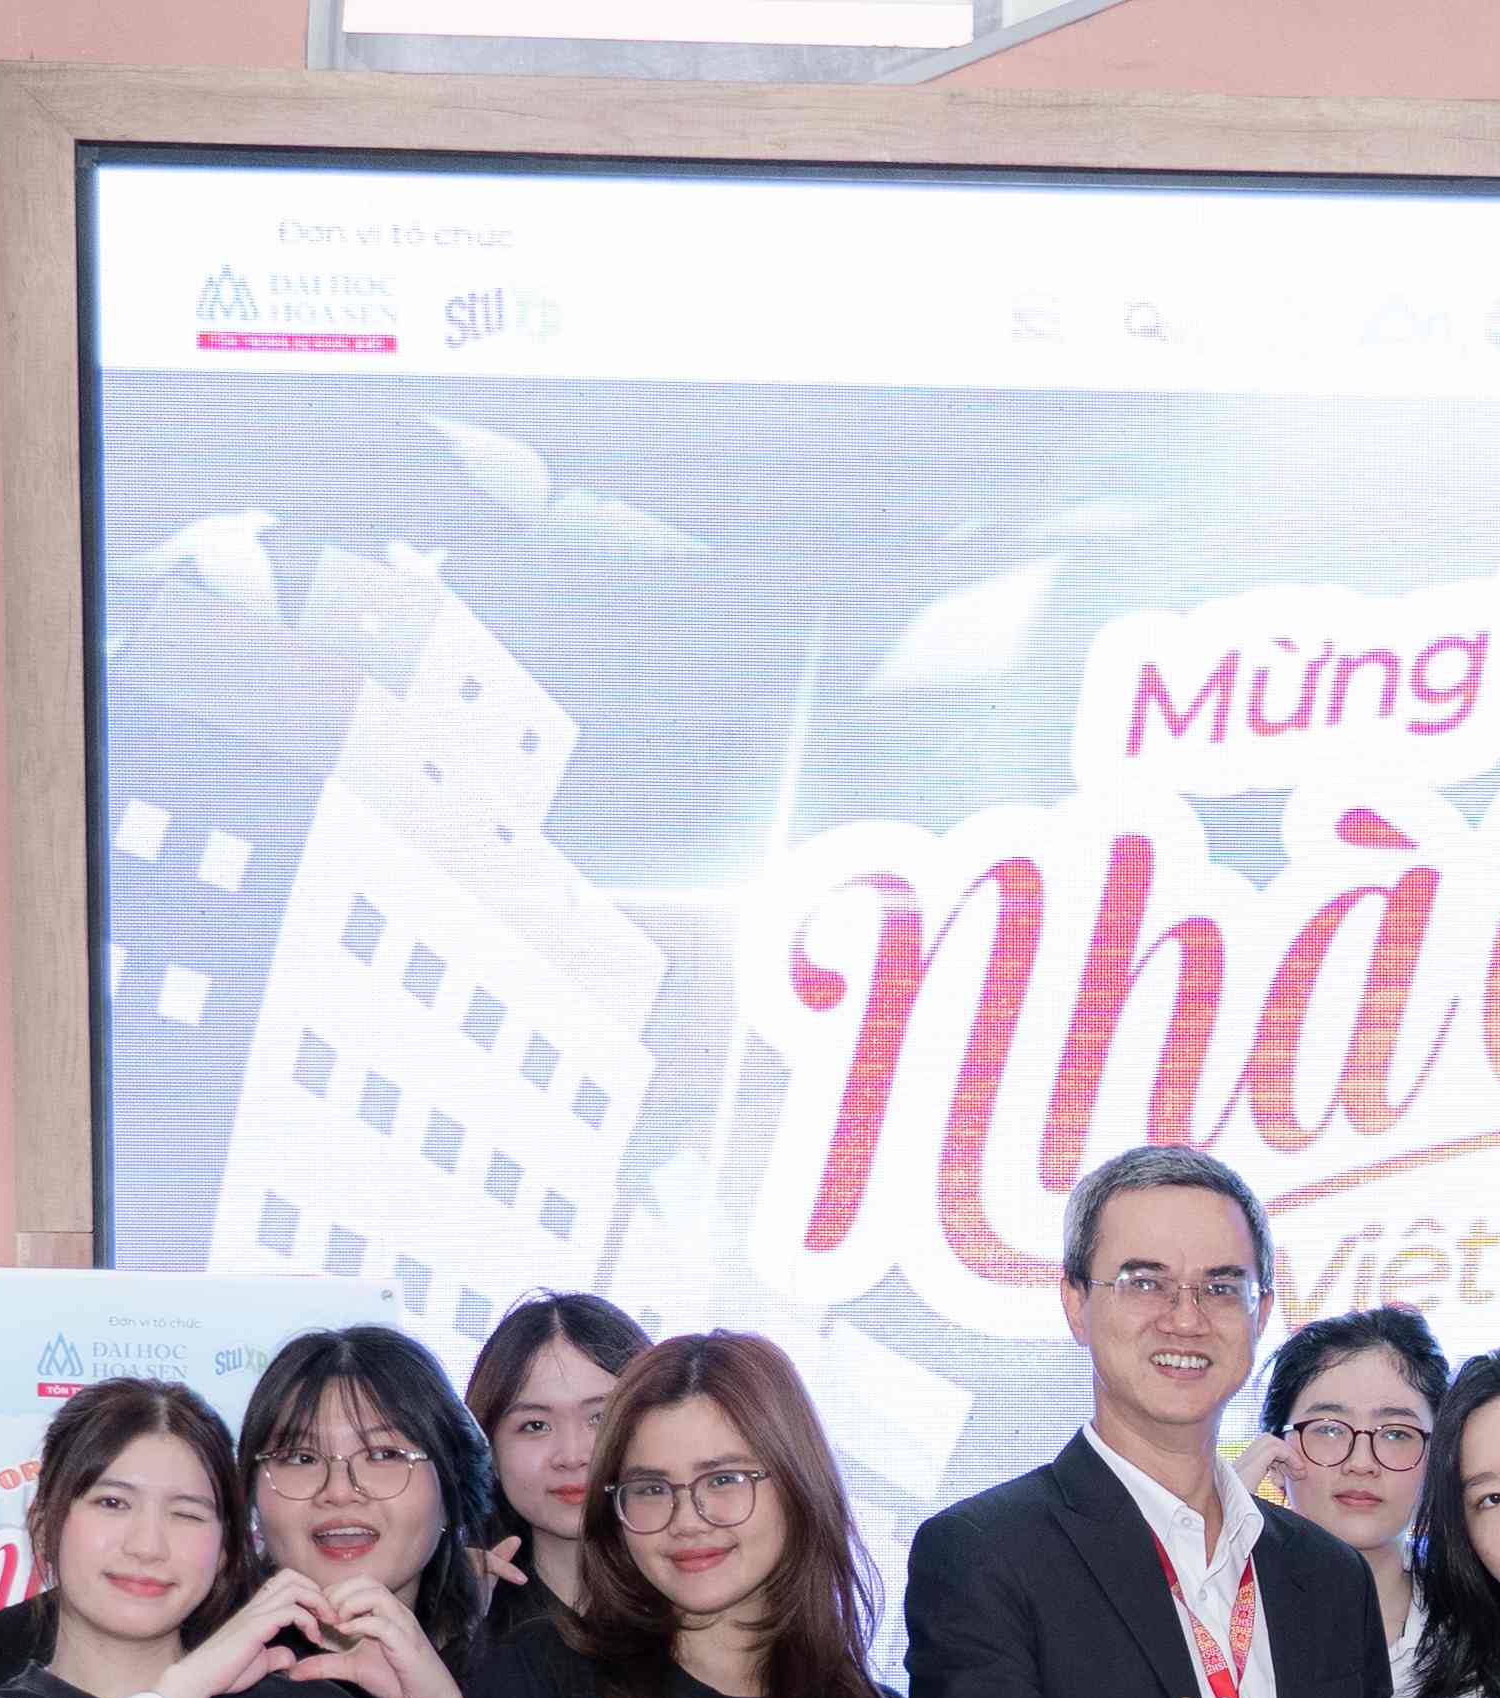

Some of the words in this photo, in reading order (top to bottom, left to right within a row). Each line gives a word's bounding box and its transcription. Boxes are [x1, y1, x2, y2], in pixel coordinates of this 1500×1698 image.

[1124, 632, 1492, 758] Mừng
[791, 806, 1460, 1290] Nhà
[46, 1383, 69, 1396] TÔN
[92, 1362, 140, 1379] HOA
[147, 1364, 189, 1379] SEN
